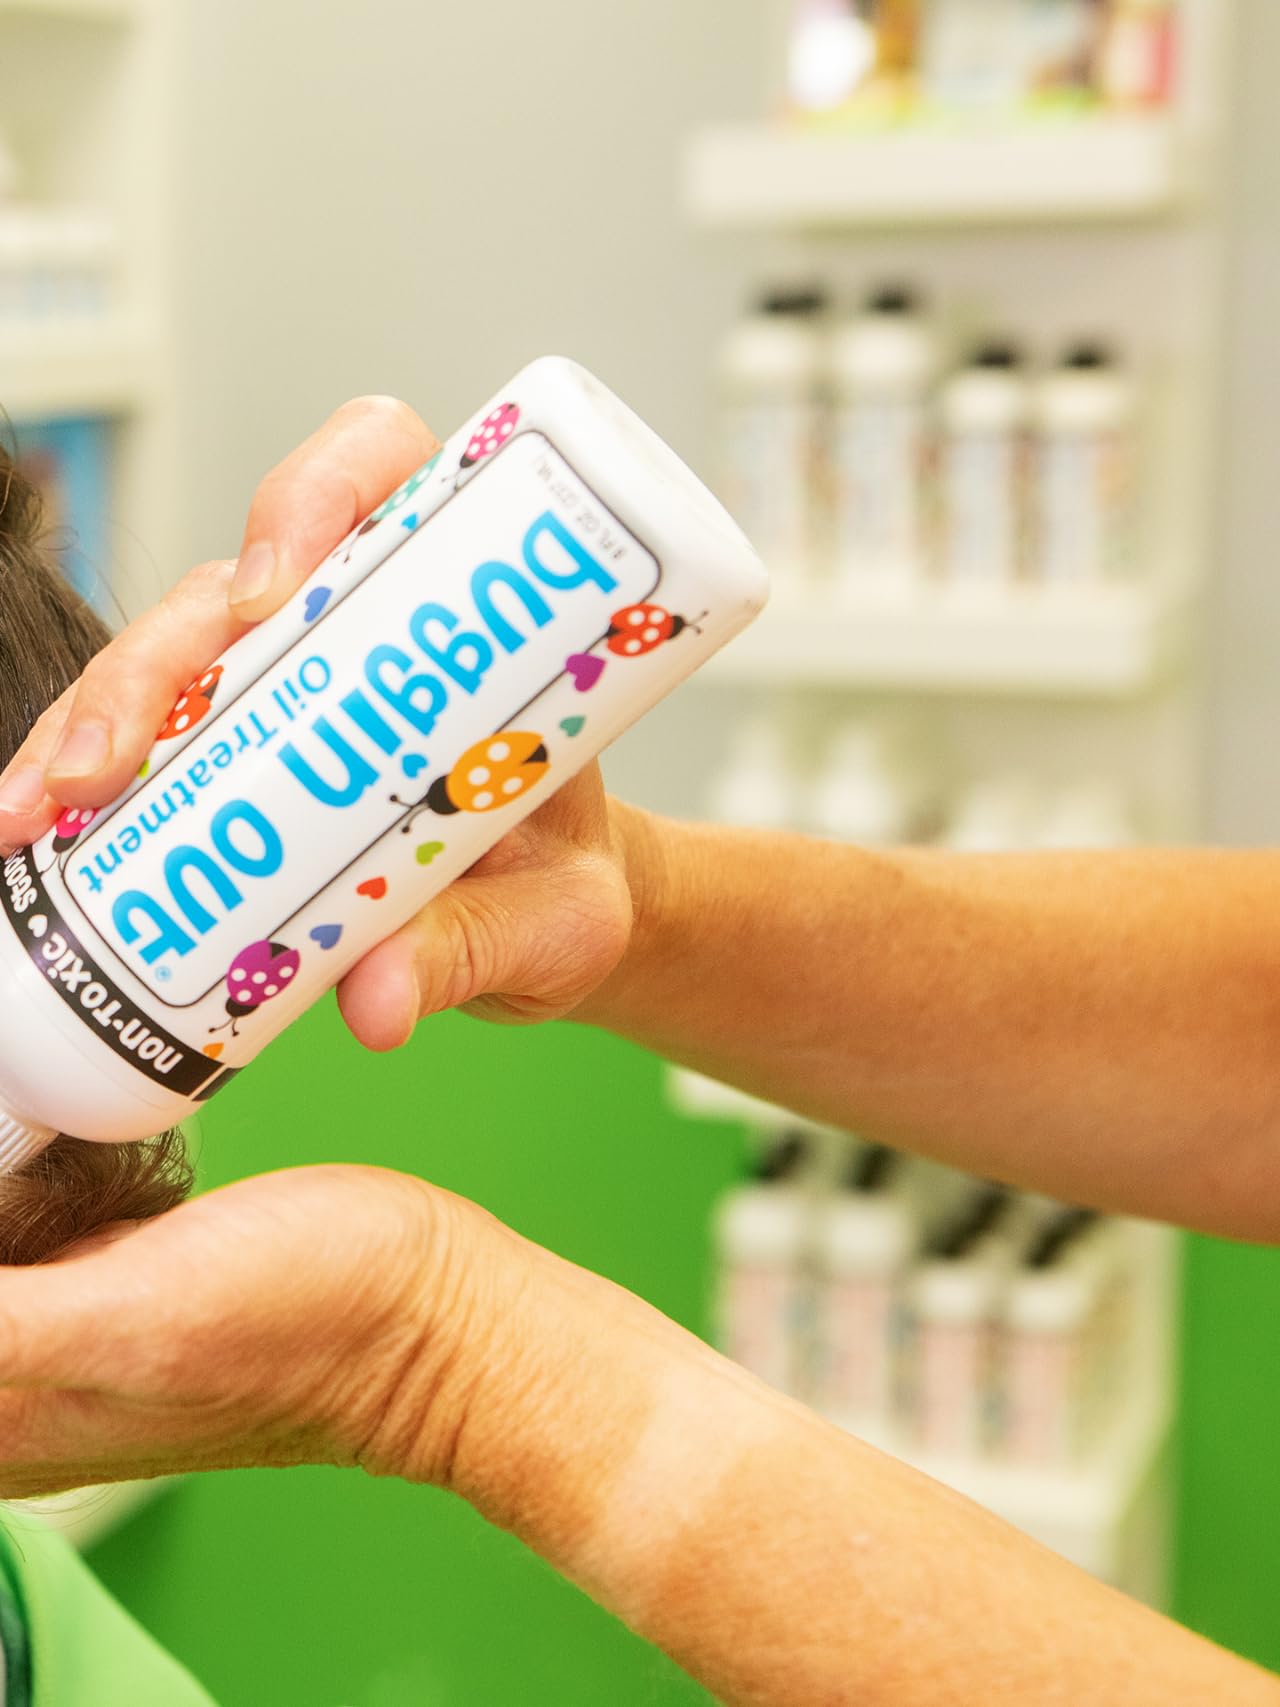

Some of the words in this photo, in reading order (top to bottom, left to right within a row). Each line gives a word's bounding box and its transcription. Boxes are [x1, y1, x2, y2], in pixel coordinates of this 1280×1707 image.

[271, 655, 332, 722] Oil
[275, 509, 619, 810] buggin
[78, 710, 279, 894] Treatment
